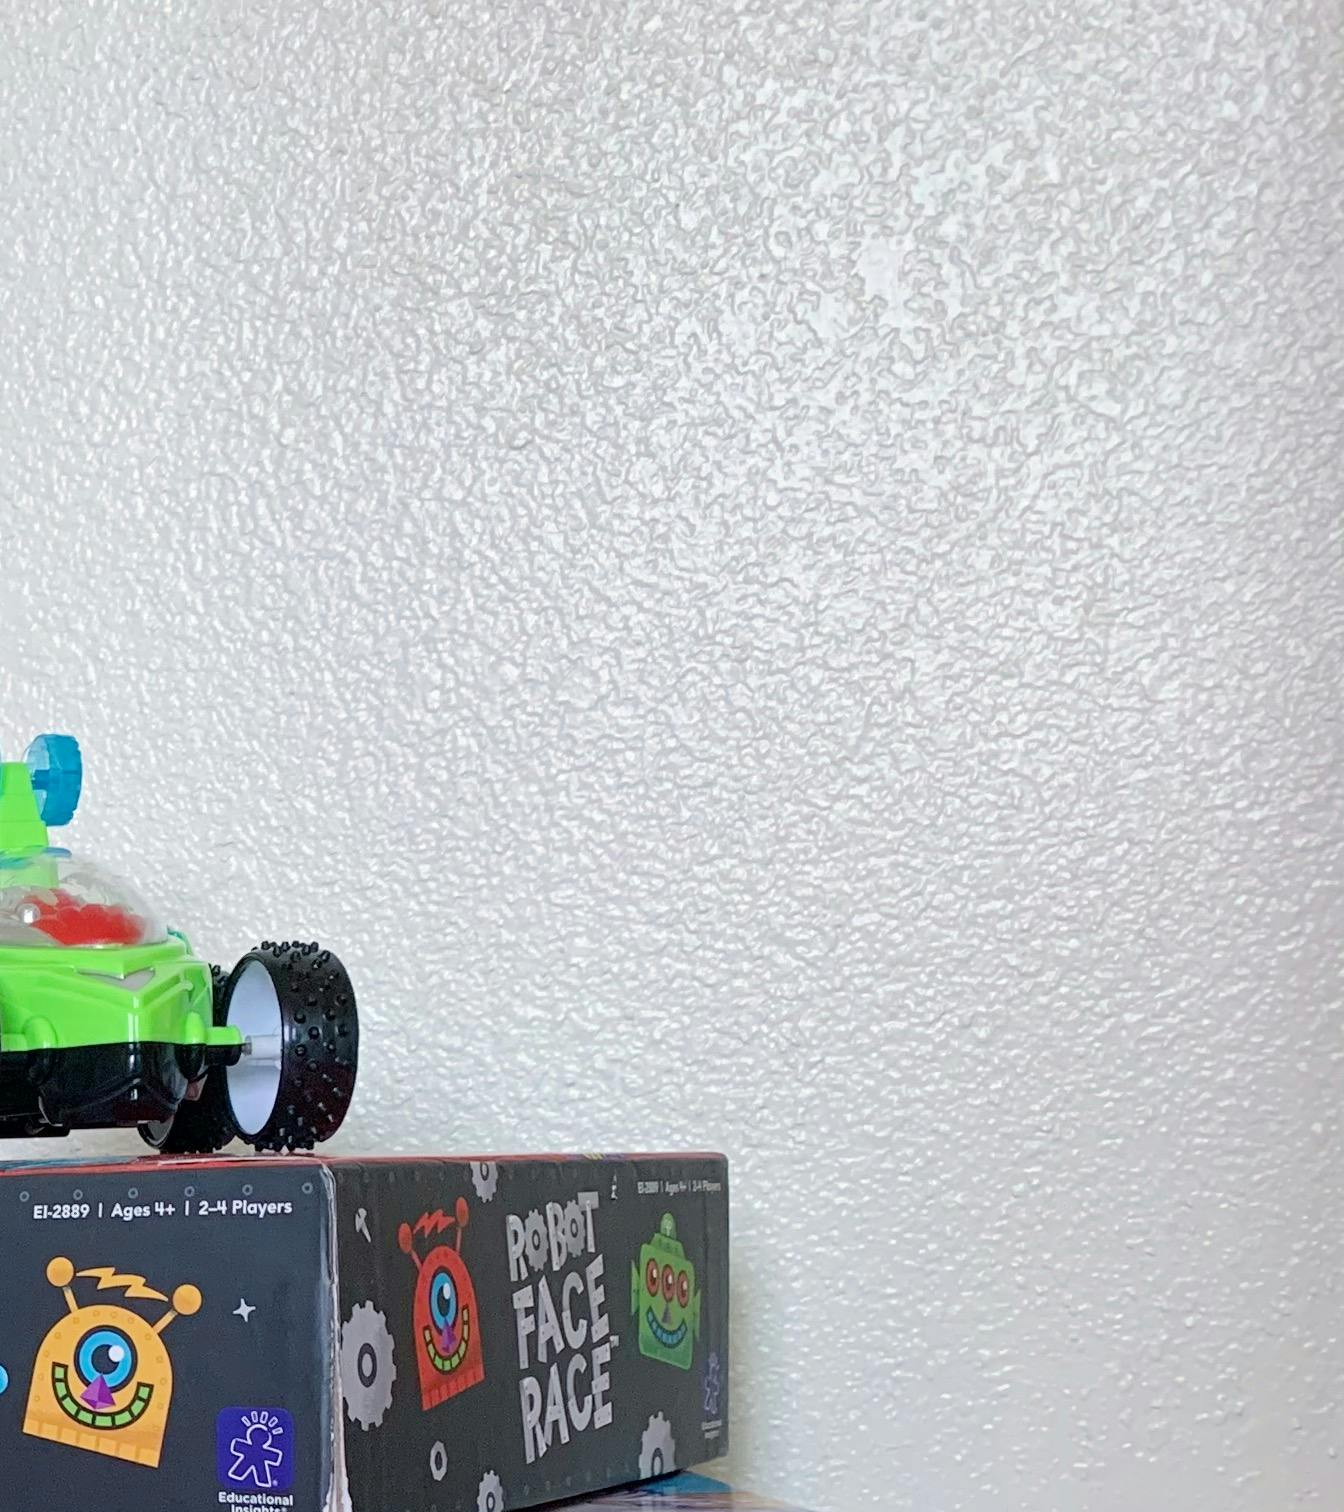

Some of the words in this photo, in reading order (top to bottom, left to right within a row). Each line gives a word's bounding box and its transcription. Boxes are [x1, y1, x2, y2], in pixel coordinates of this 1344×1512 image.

[33, 1203, 90, 1219] EI-2889
[110, 1203, 150, 1221] Ages
[154, 1202, 175, 1217] 4+
[232, 1199, 293, 1218] Players
[505, 1191, 600, 1282] ROBOT
[512, 1253, 610, 1370] FACE
[519, 1341, 613, 1464] RACE
[218, 1491, 294, 1506] Educational
